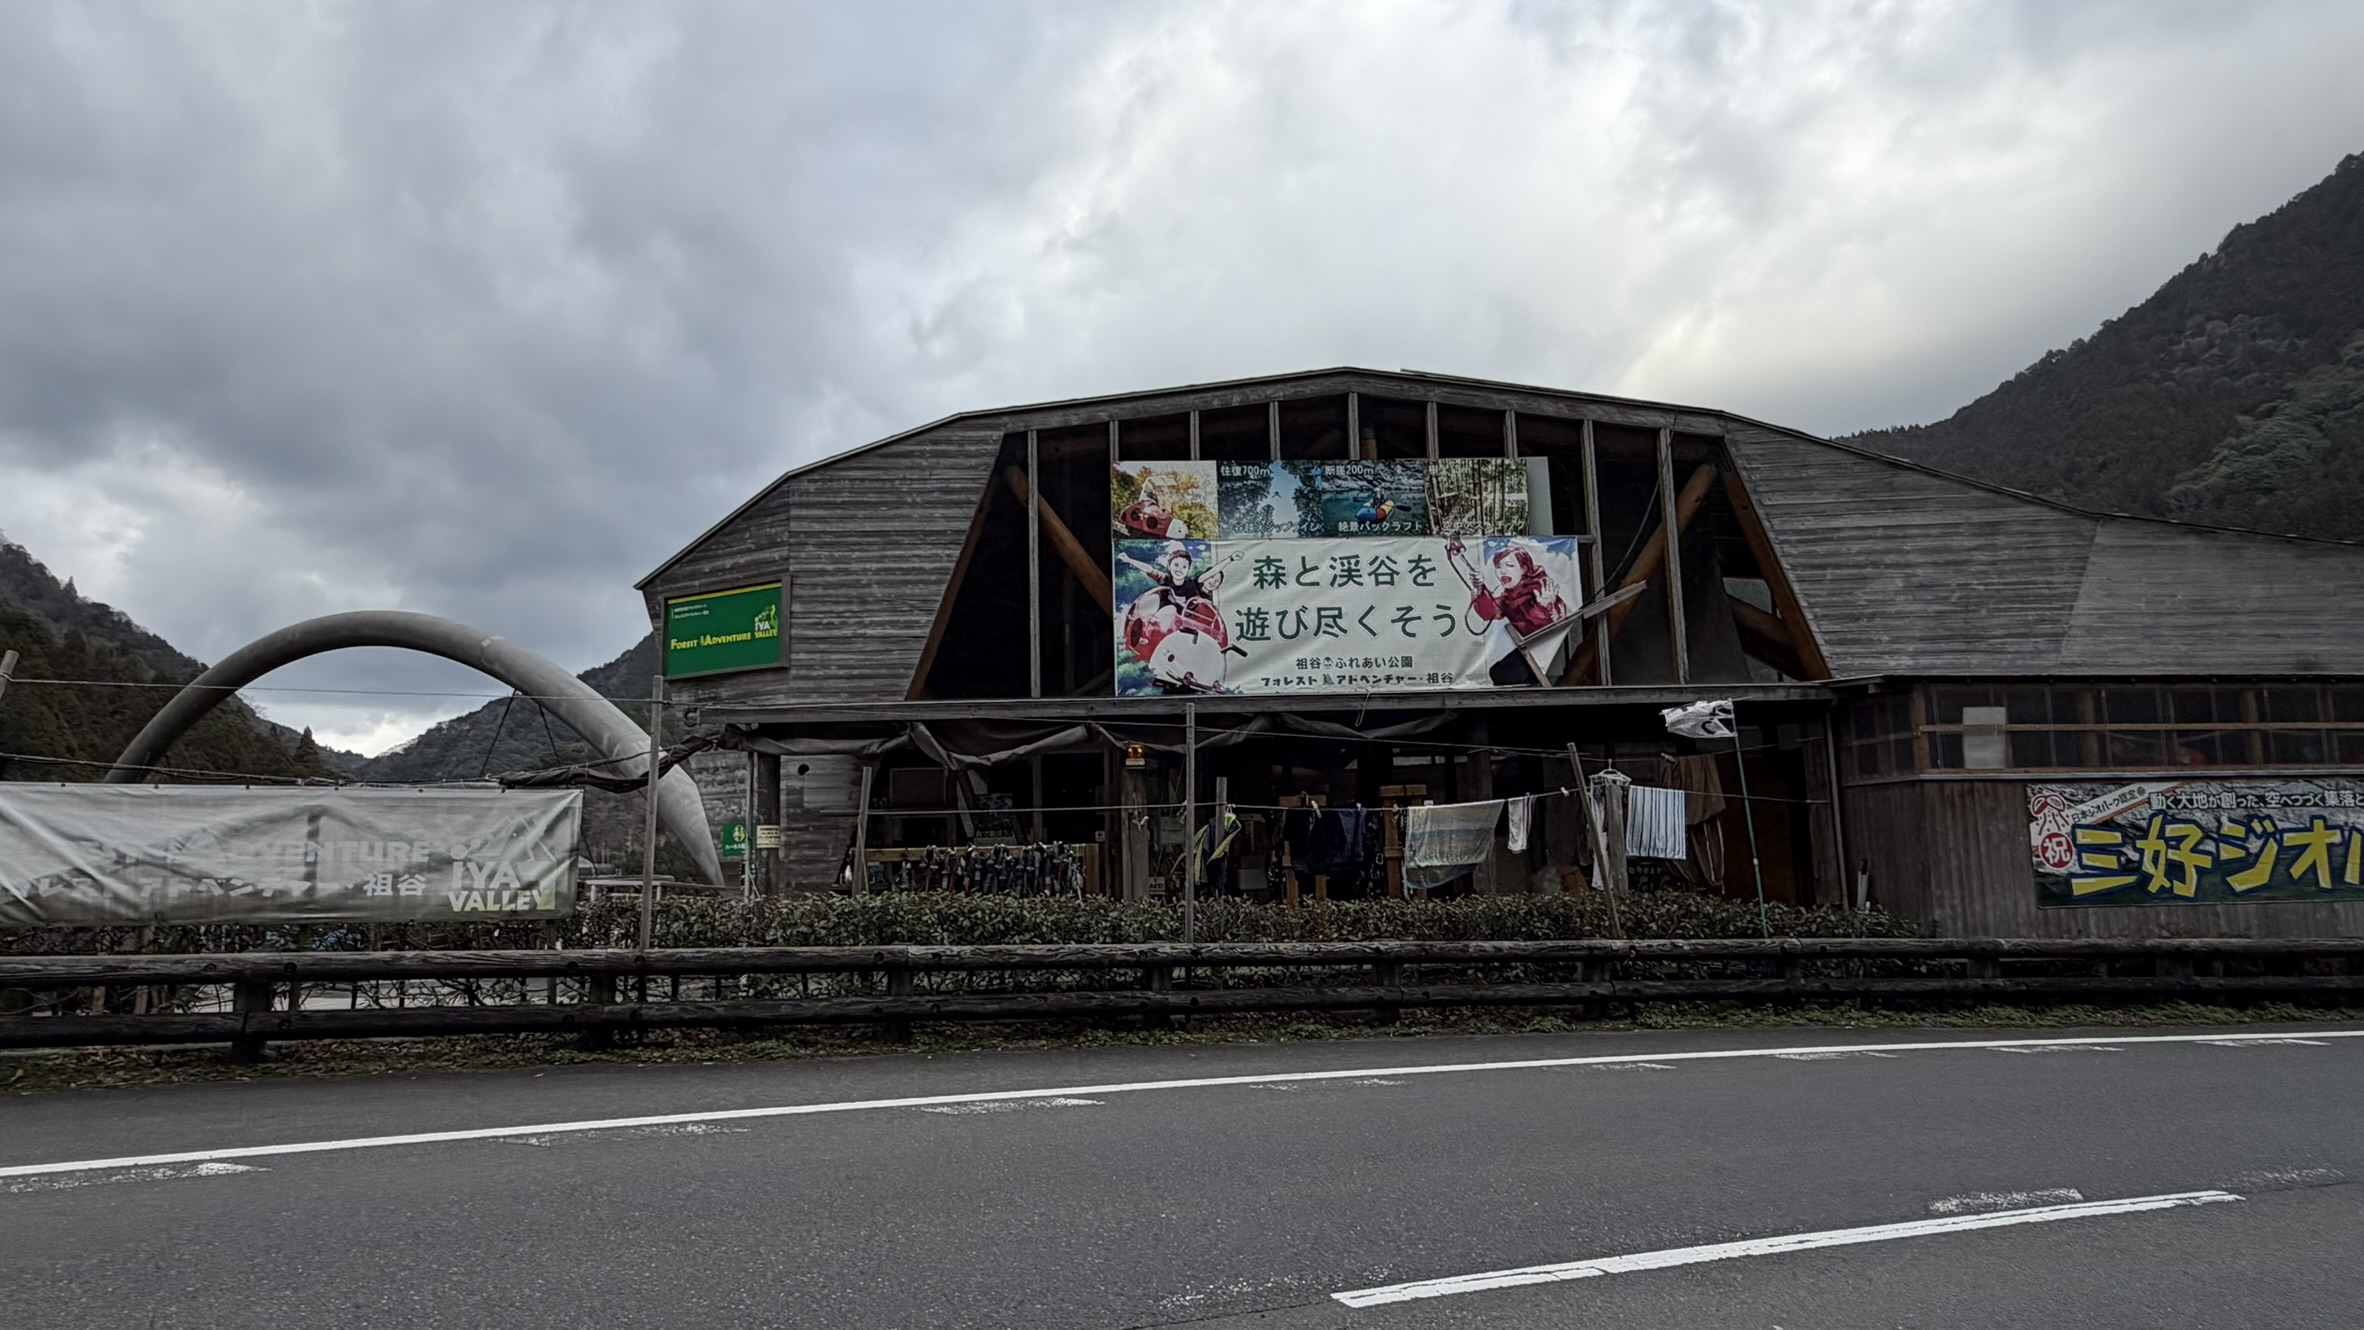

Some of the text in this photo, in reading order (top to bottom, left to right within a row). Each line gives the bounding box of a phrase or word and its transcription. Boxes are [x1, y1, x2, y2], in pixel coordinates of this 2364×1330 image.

[1338, 521, 1423, 533] 絶景パックラフト
[1253, 554, 1438, 590] 森と渓谷を
[1235, 603, 1458, 642] 遊び尽くそう
[1296, 656, 1413, 669] 祖谷 ふれあい公園
[1261, 676, 1317, 687] フォレスト
[2044, 836, 2072, 865] 祝
[451, 861, 521, 889] IYA
